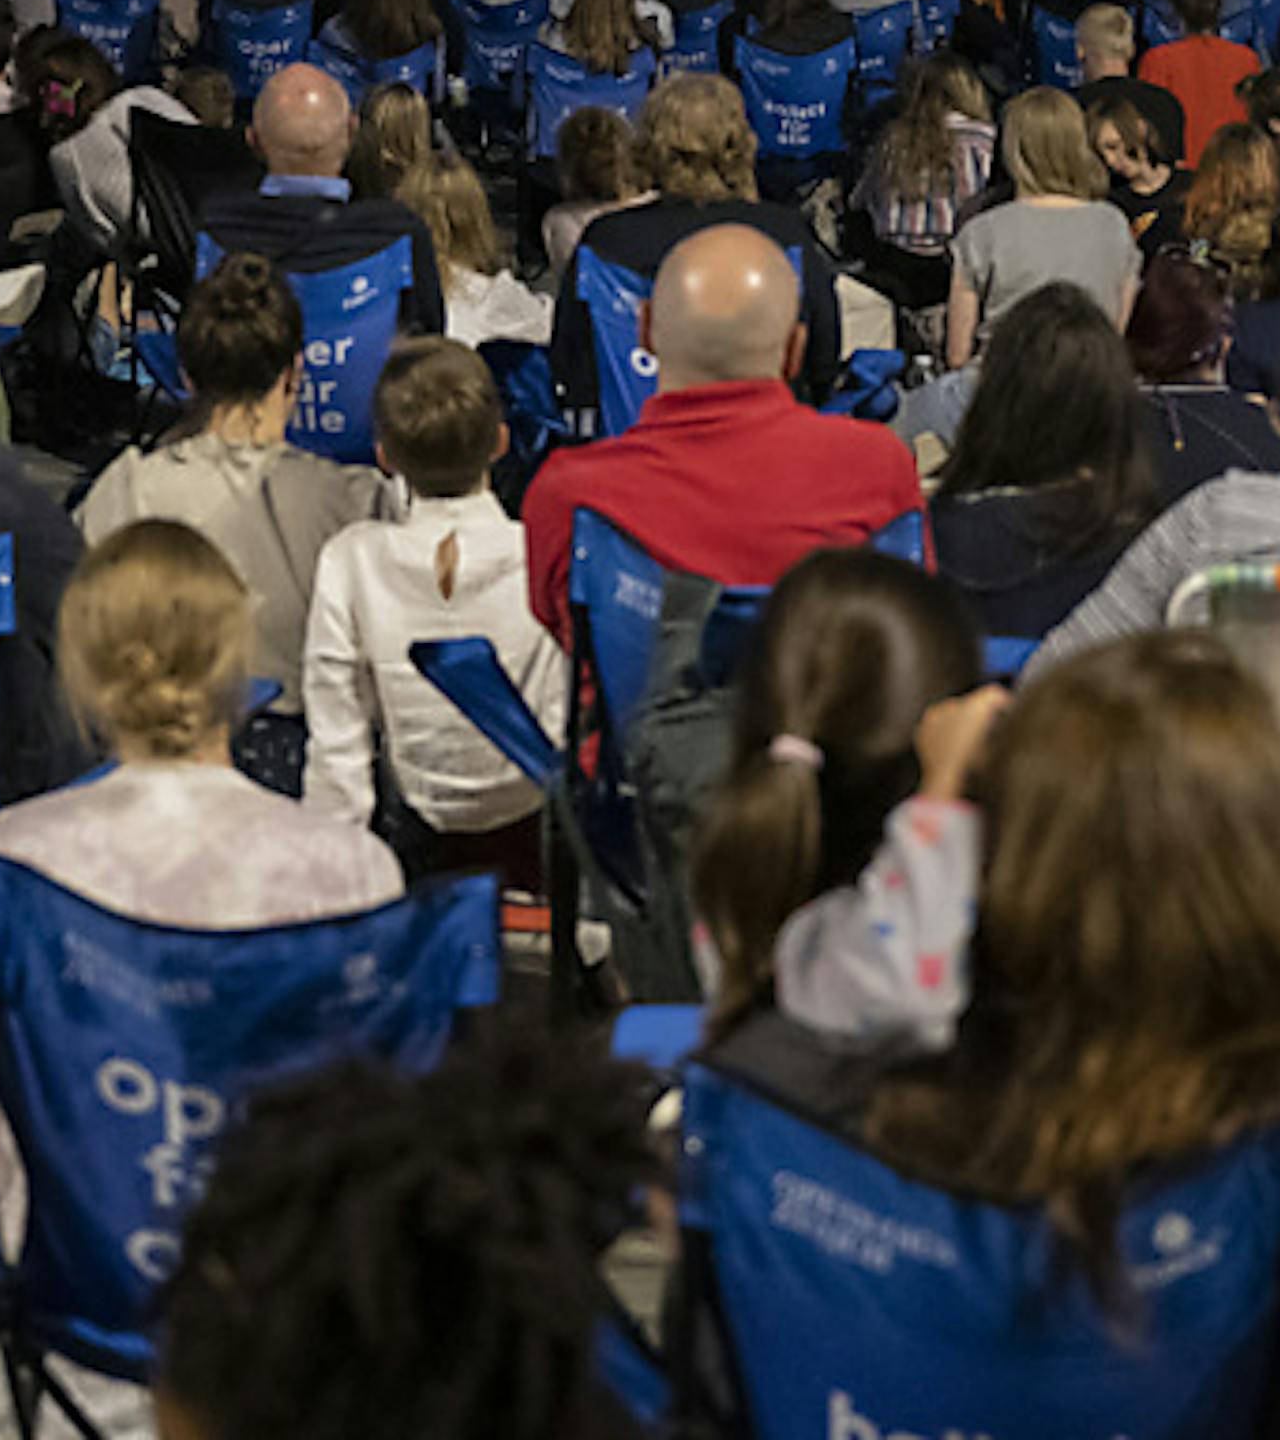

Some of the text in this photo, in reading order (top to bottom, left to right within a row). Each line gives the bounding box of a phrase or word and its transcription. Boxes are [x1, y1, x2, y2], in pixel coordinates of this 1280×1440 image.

[304, 336, 356, 367] er
[290, 405, 348, 434] lle
[94, 1055, 225, 1148] op
